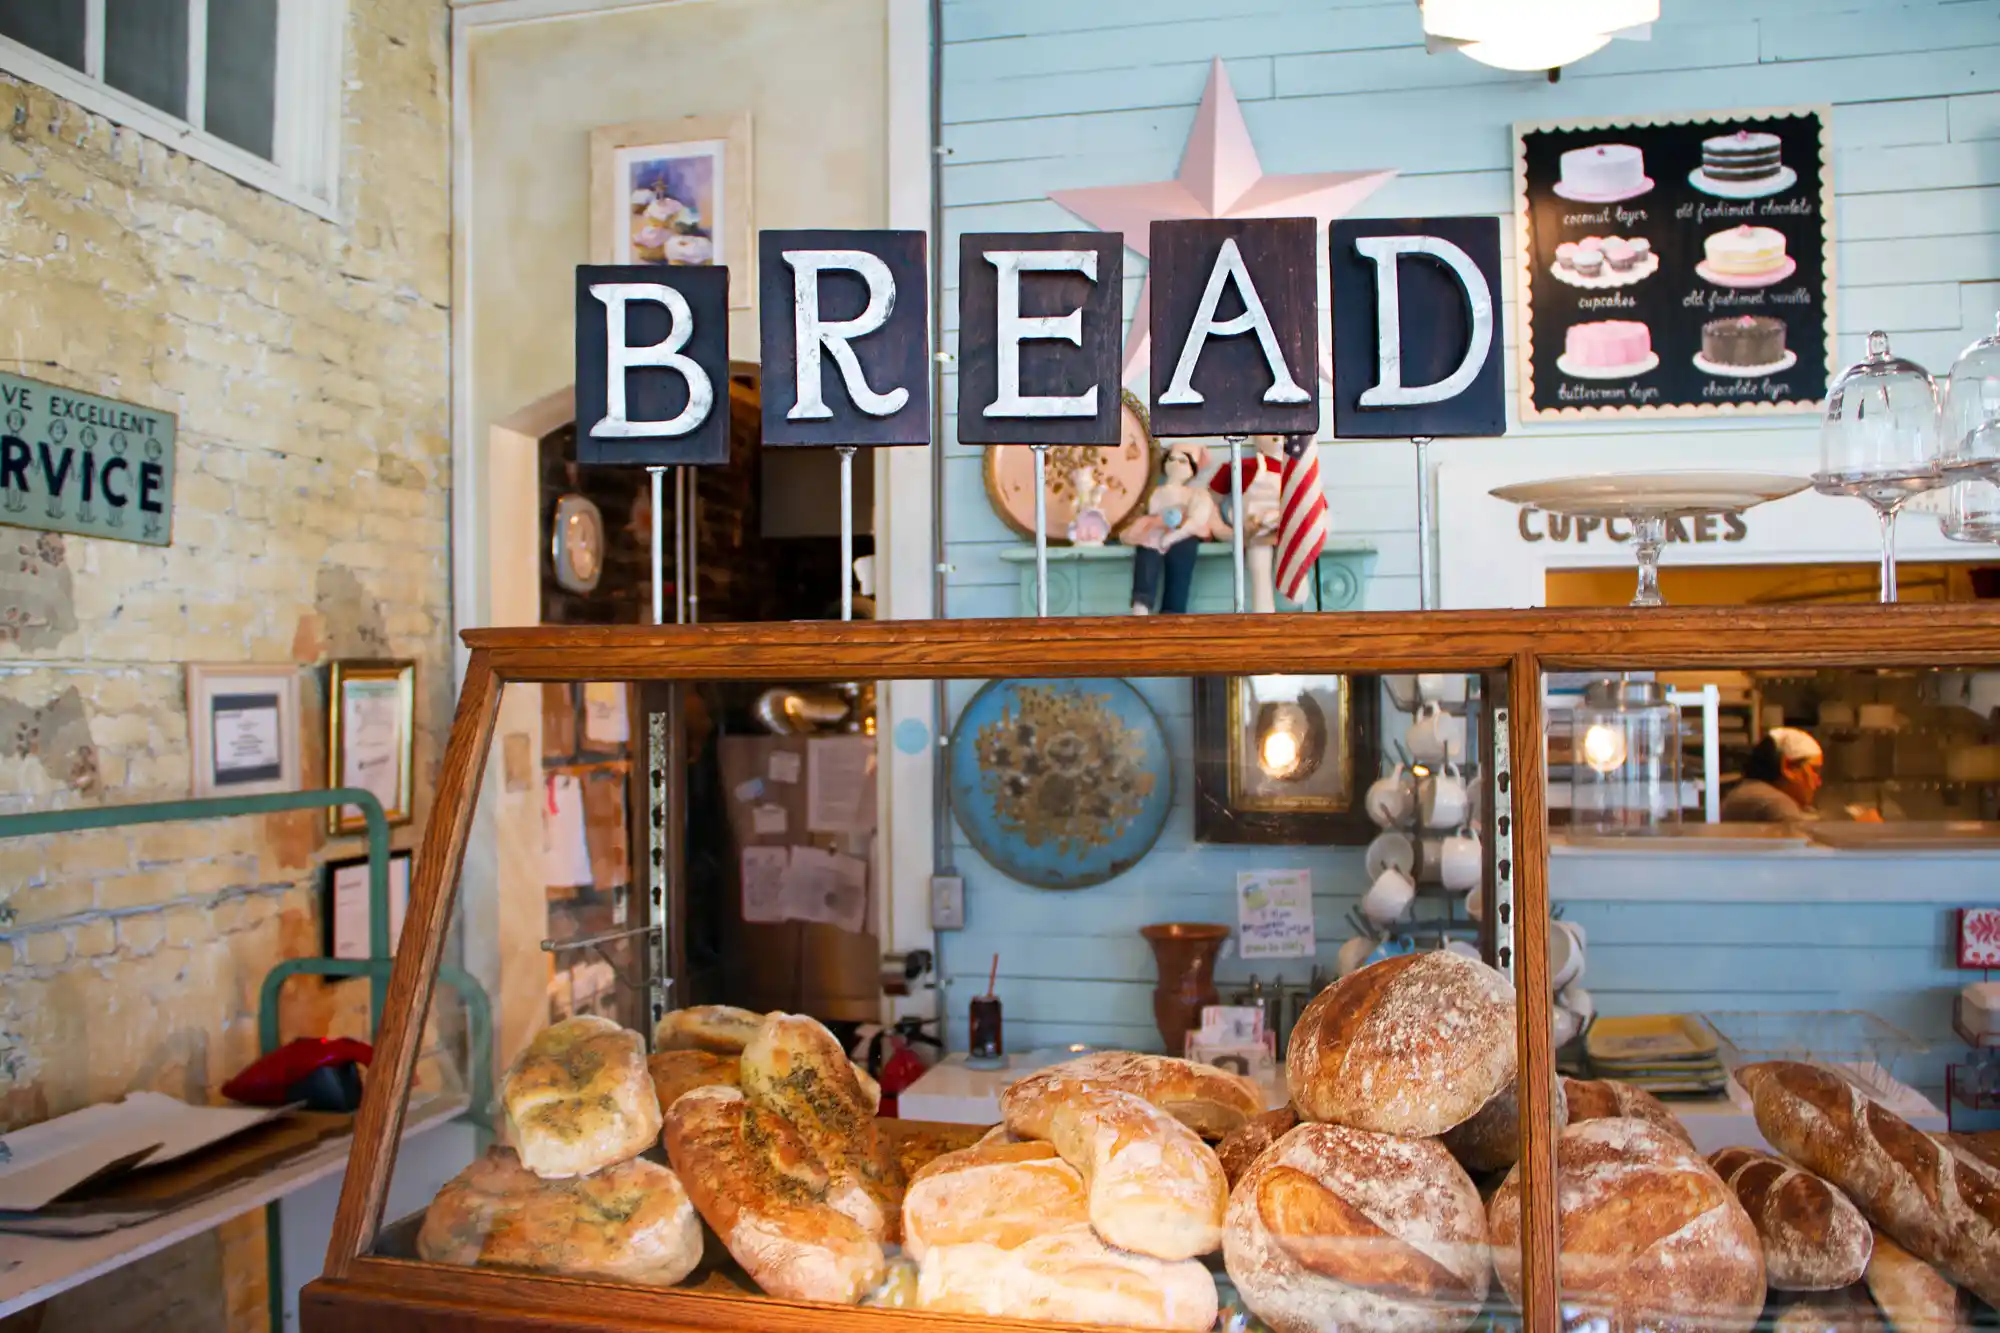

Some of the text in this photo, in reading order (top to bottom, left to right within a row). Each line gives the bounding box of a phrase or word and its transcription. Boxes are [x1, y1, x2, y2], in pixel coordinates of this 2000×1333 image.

[1563, 205, 1648, 228] coconut layer
[1676, 201, 1693, 219] old
[1760, 197, 1812, 216] chocolate
[1578, 291, 1636, 312] cupcakes
[1682, 290, 1704, 307] old
[588, 236, 1493, 439] BREAD
[1702, 379, 1757, 397] chocolate
[50, 396, 157, 436] EXCELLENT
[1518, 506, 1748, 543] CUPCKES
